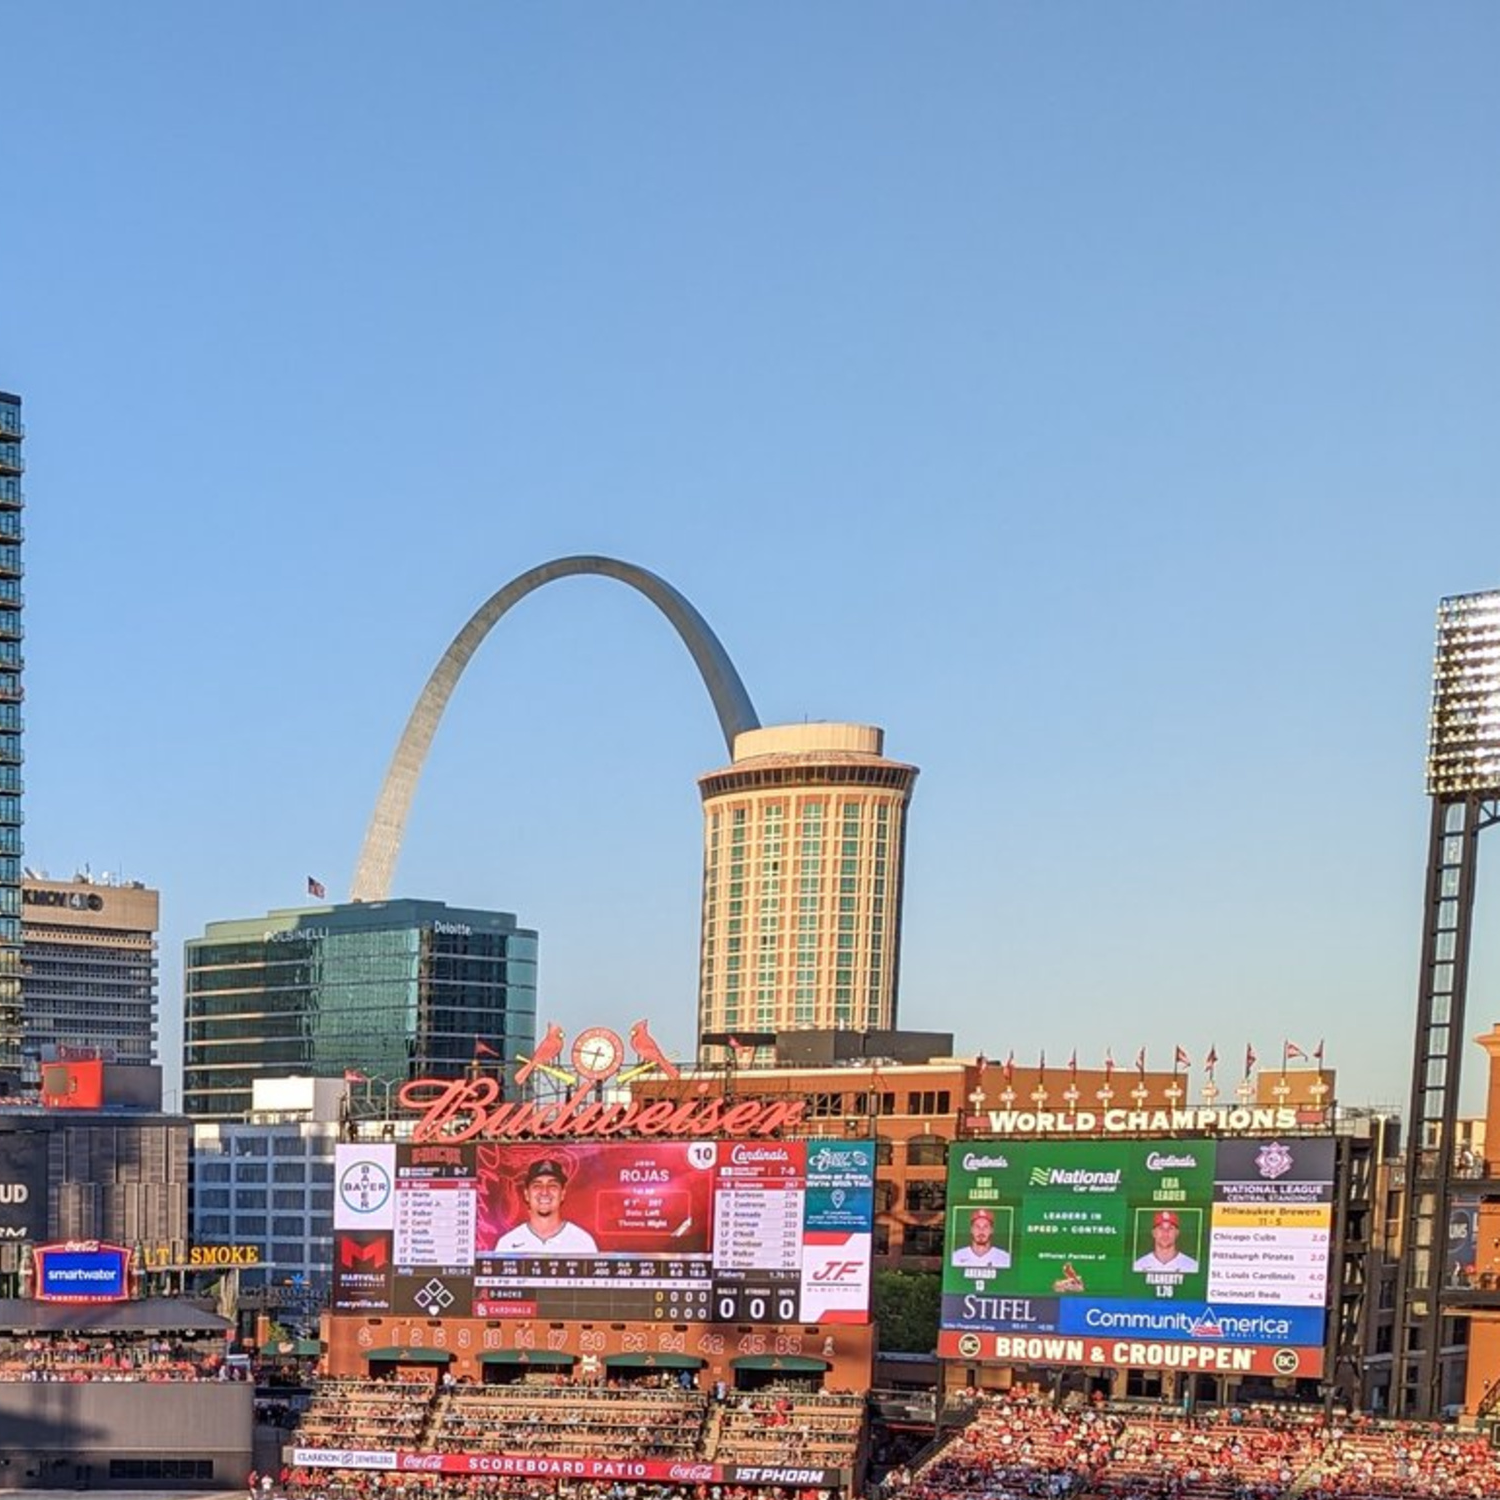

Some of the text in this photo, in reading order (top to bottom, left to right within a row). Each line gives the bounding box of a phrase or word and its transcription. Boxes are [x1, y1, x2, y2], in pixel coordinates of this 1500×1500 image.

[263, 927, 329, 943] POLSINELLI
[399, 1077, 806, 1143] Budweiser
[988, 1108, 1297, 1133] WORLD CHAMPIONS
[693, 1147, 712, 1161] 10
[731, 1144, 788, 1164] Cardinals
[962, 1152, 1008, 1171] Cardinals
[1146, 1151, 1197, 1170] Cardinals
[619, 1169, 670, 1182] ROJAS
[1049, 1168, 1121, 1185] National
[344, 1181, 387, 1192] BAYER
[361, 1165, 370, 1209] BAYER
[1222, 1185, 1323, 1194] NATIONAL LEAGUE
[1222, 1207, 1322, 1217] Milwaukee Brewers
[1071, 1225, 1117, 1235] CONTROL
[1213, 1233, 1250, 1242] Chicago
[1253, 1233, 1277, 1242] Cubs
[190, 1246, 259, 1264] SMOKE
[1212, 1252, 1259, 1262] Pittsburgh
[1262, 1253, 1294, 1262] Pirates
[47, 1268, 117, 1282] smartwater
[1225, 1271, 1249, 1280] Louis
[1252, 1272, 1296, 1281] Cardinals
[1210, 1289, 1255, 1299] Cincinnati
[1258, 1291, 1281, 1299] Reds
[963, 1294, 1036, 1322] STIFEL
[995, 1336, 1252, 1370] BROWN & CROUPPEN
[468, 1457, 646, 1477] SCOREBOARD PATIO
[735, 1467, 825, 1483] 1ST PHORM
